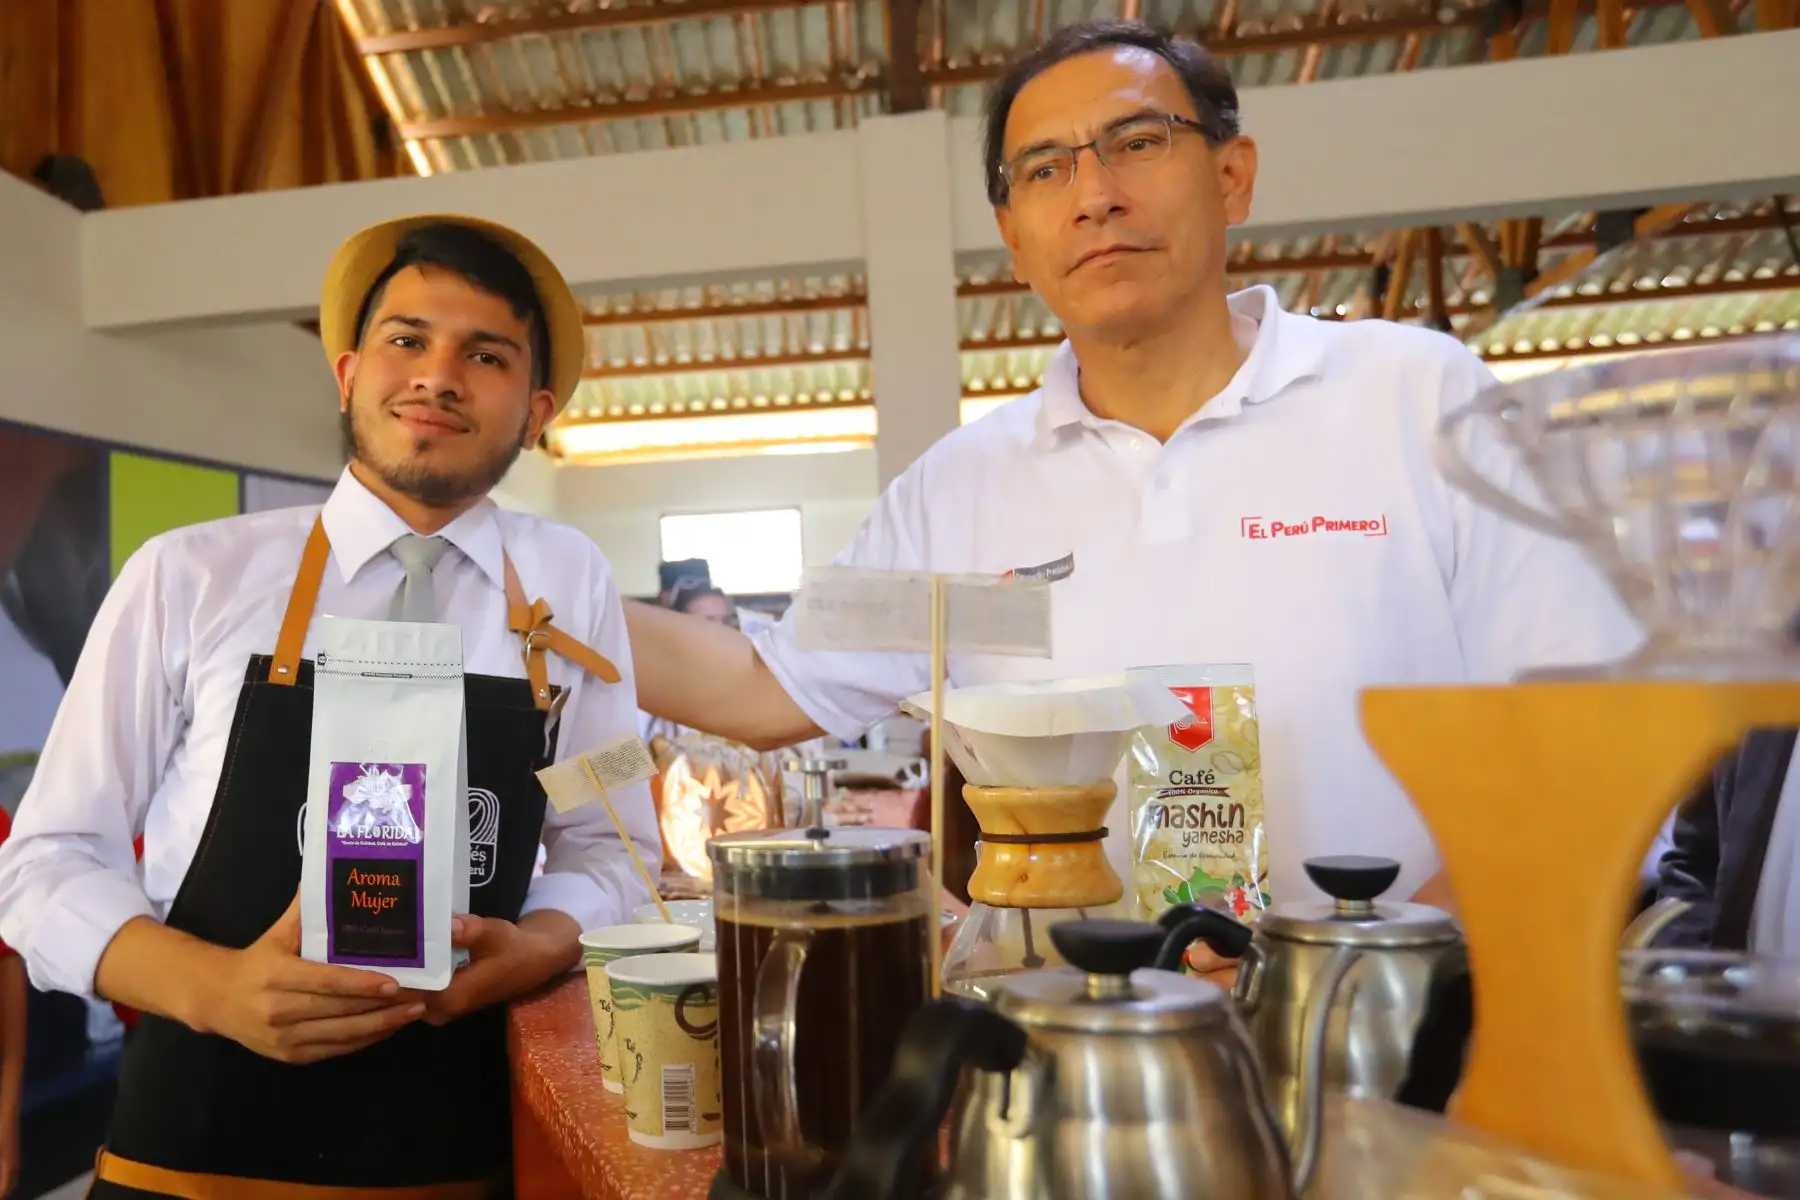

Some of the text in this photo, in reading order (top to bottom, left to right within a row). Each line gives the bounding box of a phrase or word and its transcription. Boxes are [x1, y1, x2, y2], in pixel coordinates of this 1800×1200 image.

[1248, 516, 1380, 539] EL PERÚ PRIMERO
[1168, 769, 1216, 785] Café
[1168, 788, 1187, 796] 100%
[336, 825, 414, 840] LA FLORIDA
[1182, 830, 1245, 848] yanesha
[347, 868, 401, 886] Aroma
[469, 863, 485, 876] erú
[351, 890, 398, 915] Mujer
